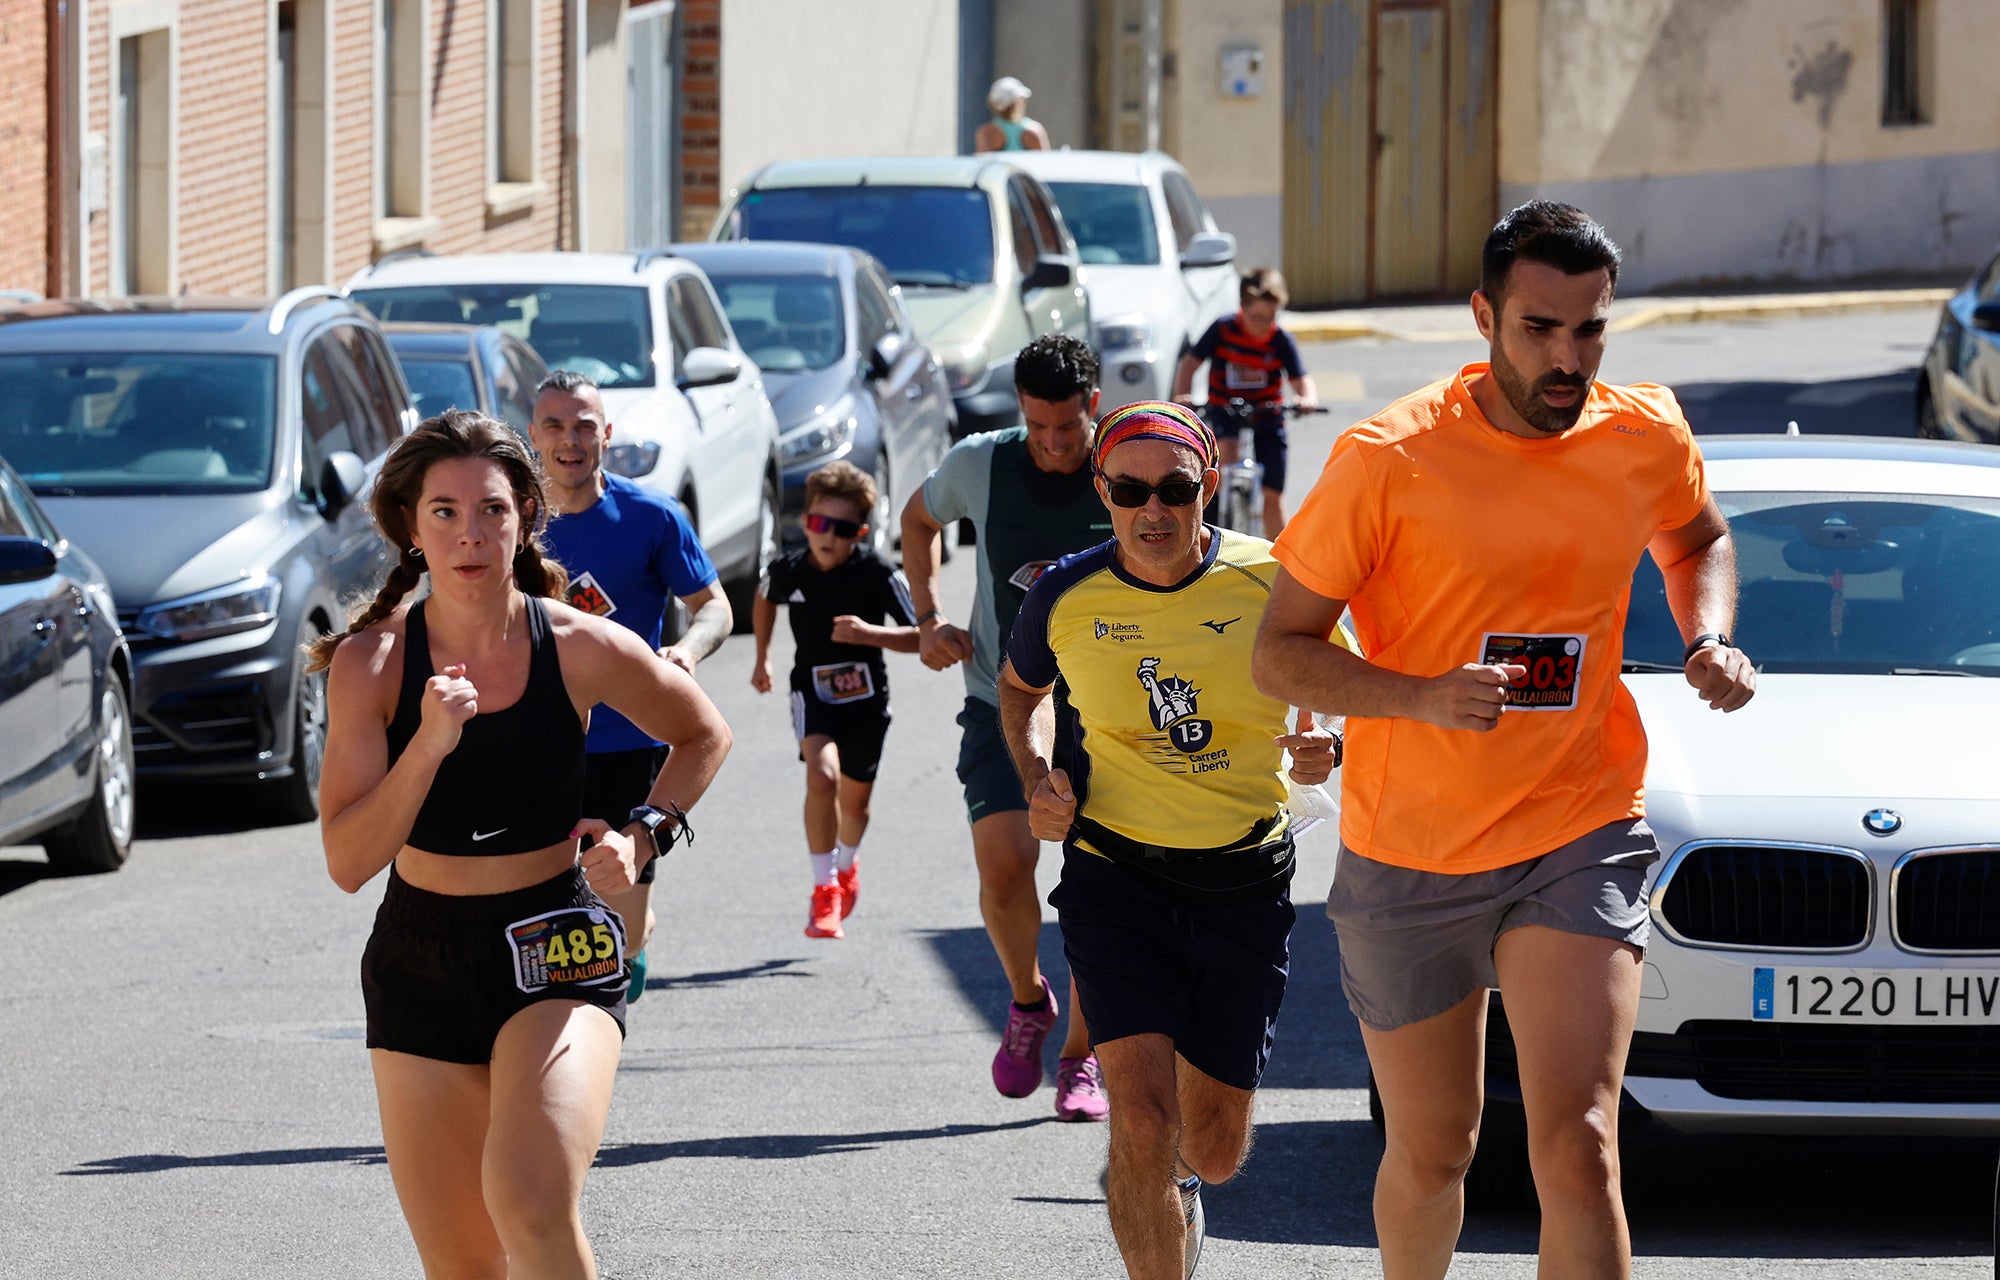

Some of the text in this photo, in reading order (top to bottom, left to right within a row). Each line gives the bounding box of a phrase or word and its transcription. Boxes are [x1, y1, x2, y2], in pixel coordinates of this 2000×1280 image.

[1111, 623, 1140, 633] Liberty
[1111, 633, 1145, 643] Seguros.
[1178, 721, 1204, 743] 13
[1189, 749, 1228, 763] Carrera
[1192, 760, 1230, 773] Liberty
[546, 924, 615, 967] 485
[548, 958, 617, 982] VILLALOBÓN
[1787, 975, 2000, 1017] 1220 LHV
[1759, 999, 1768, 1011] E
